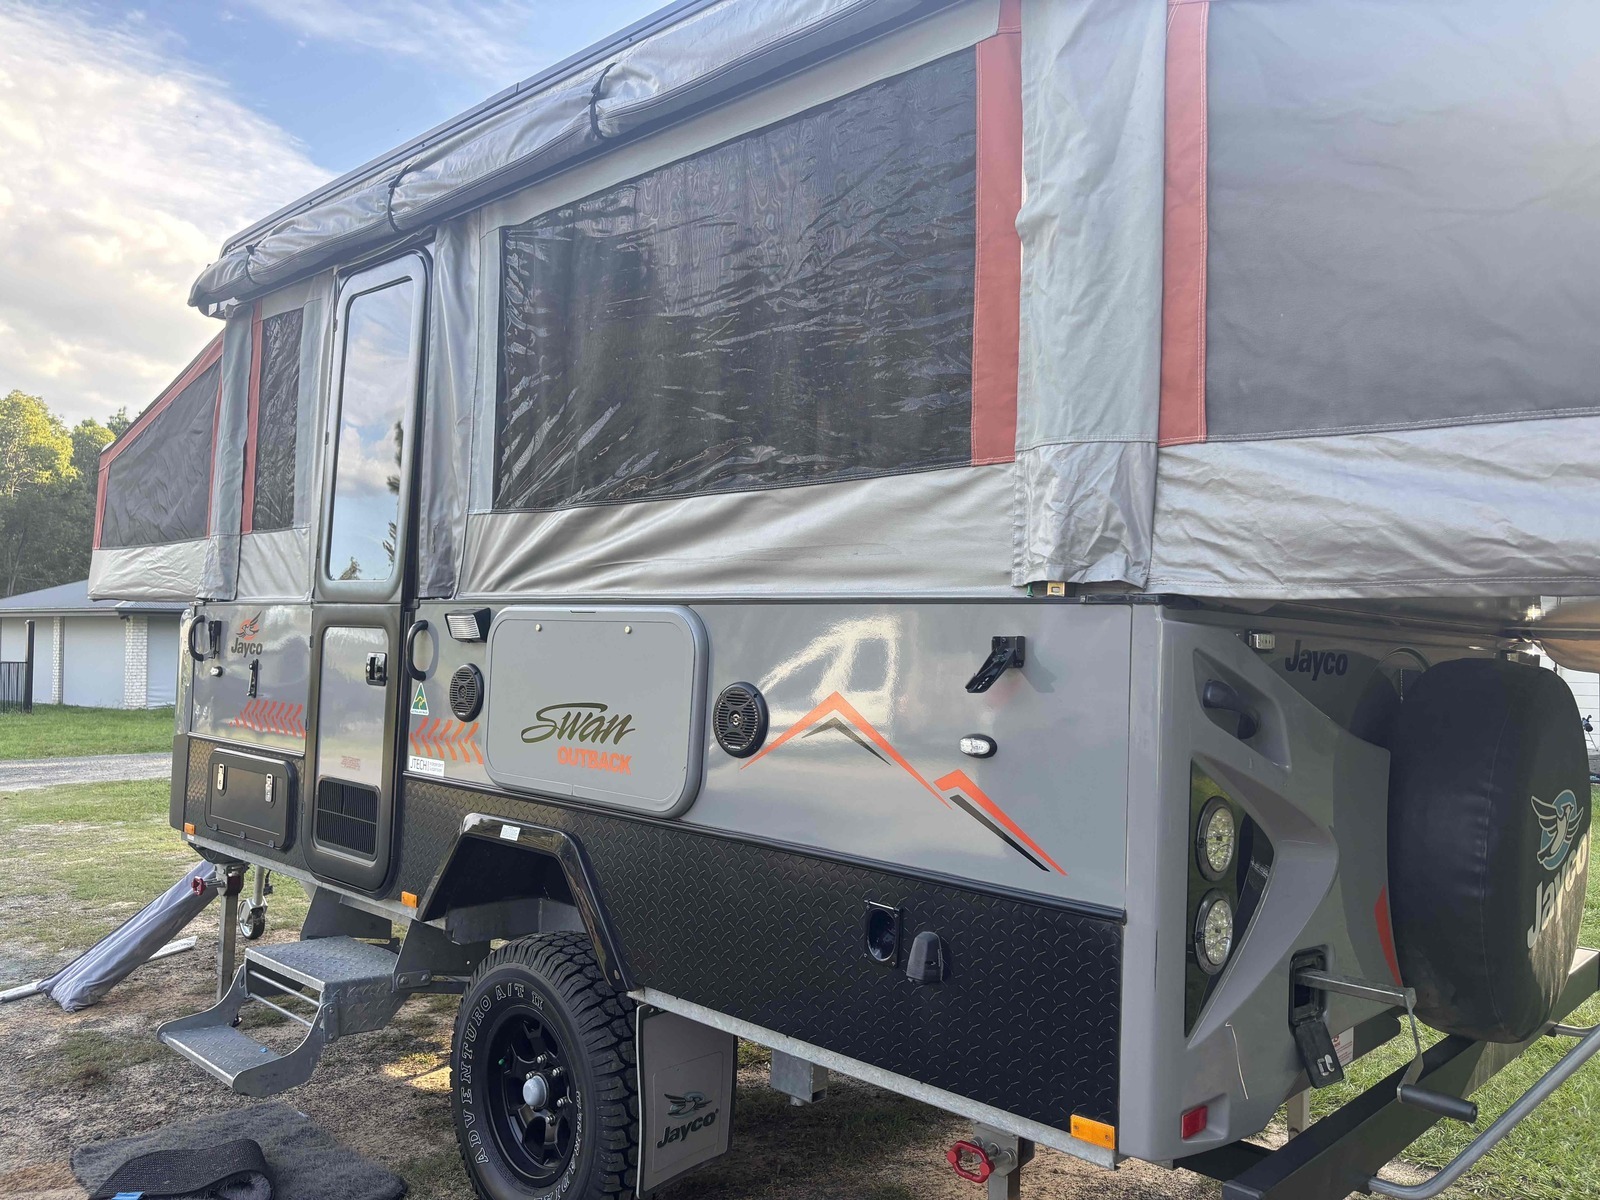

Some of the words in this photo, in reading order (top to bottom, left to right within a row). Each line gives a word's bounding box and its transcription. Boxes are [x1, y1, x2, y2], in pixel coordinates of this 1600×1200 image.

[231, 637, 263, 658] Jayco
[1285, 640, 1348, 681] Jayco
[521, 702, 636, 745] Swan
[557, 746, 632, 775] OUTBACK
[1527, 833, 1587, 949] Jayco
[460, 994, 492, 1163] ADVENTURO
[656, 1112, 716, 1149] Jayco
